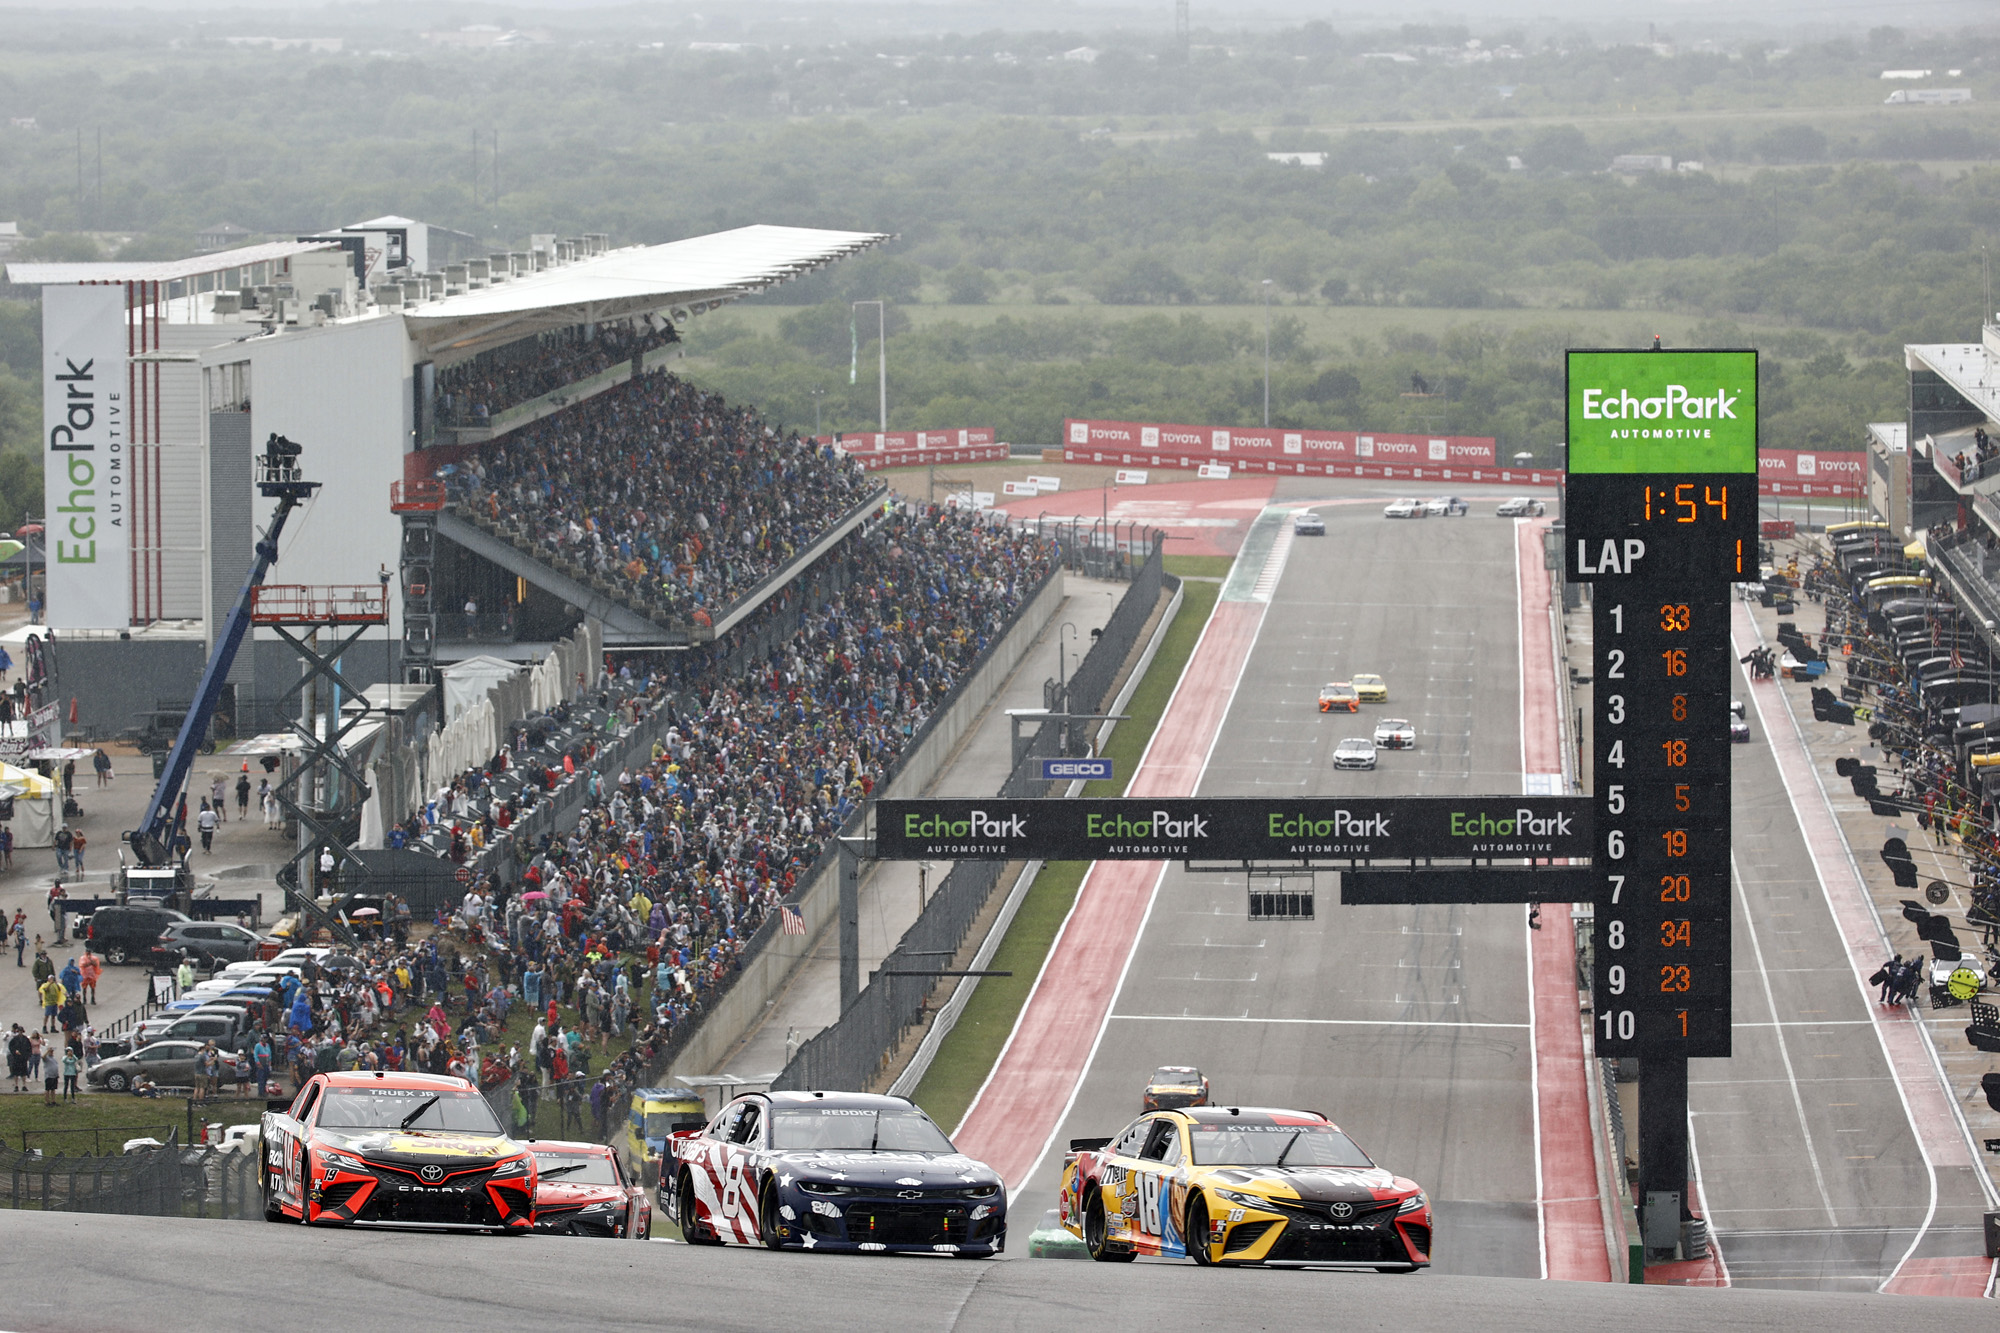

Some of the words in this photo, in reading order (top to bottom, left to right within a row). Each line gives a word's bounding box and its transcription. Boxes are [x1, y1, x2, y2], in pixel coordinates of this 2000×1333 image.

[1583, 385, 1737, 419] EchoPark
[1091, 429, 1130, 440] TOYOTA
[1162, 433, 1202, 444] TOYOTA
[1233, 437, 1272, 448] TOYOTA
[1304, 440, 1345, 450] TOYOTA
[1611, 428, 1711, 438] AUTOMOTIVE
[51, 358, 95, 563] EchoPark
[110, 392, 122, 527] AUTOMOTIVE
[1376, 442, 1418, 453] TOYOTA
[1450, 446, 1491, 456] TOYOTA
[1758, 458, 1786, 468] YOTA
[1819, 461, 1860, 471] TOYOTA
[1644, 484, 1726, 522] 1:54
[1578, 538, 1646, 574] LAP
[1736, 539, 1742, 574] 1
[1610, 605, 1622, 633] 1
[1660, 605, 1690, 632] 33
[1608, 650, 1624, 678] 2
[1662, 650, 1686, 676] 16
[1608, 695, 1625, 724] 3
[1672, 696, 1686, 722] 8
[1608, 740, 1625, 768] 4
[1662, 740, 1686, 766] 18
[1050, 764, 1104, 774] GEICO
[1608, 785, 1625, 814] 5
[1675, 786, 1690, 811] 5
[905, 811, 1026, 838] EchoPark
[1088, 811, 1208, 838] EchoPark
[1269, 810, 1390, 837] EchoPark
[1451, 809, 1572, 836] EchoPark
[1608, 830, 1624, 859] 6
[1662, 830, 1686, 856] 19
[1608, 876, 1625, 904] 7
[1660, 876, 1690, 902] 20
[1608, 920, 1625, 950] 8
[1660, 920, 1690, 947] 34
[1608, 965, 1625, 995] 9
[1660, 966, 1690, 992] 23
[1600, 1010, 1635, 1040] 10
[1677, 1010, 1688, 1036] 1
[324, 1168, 339, 1181] 19
[722, 1154, 745, 1218] 8
[811, 1201, 824, 1213] 8
[1135, 1170, 1162, 1236] 18
[1228, 1208, 1247, 1222] 18
